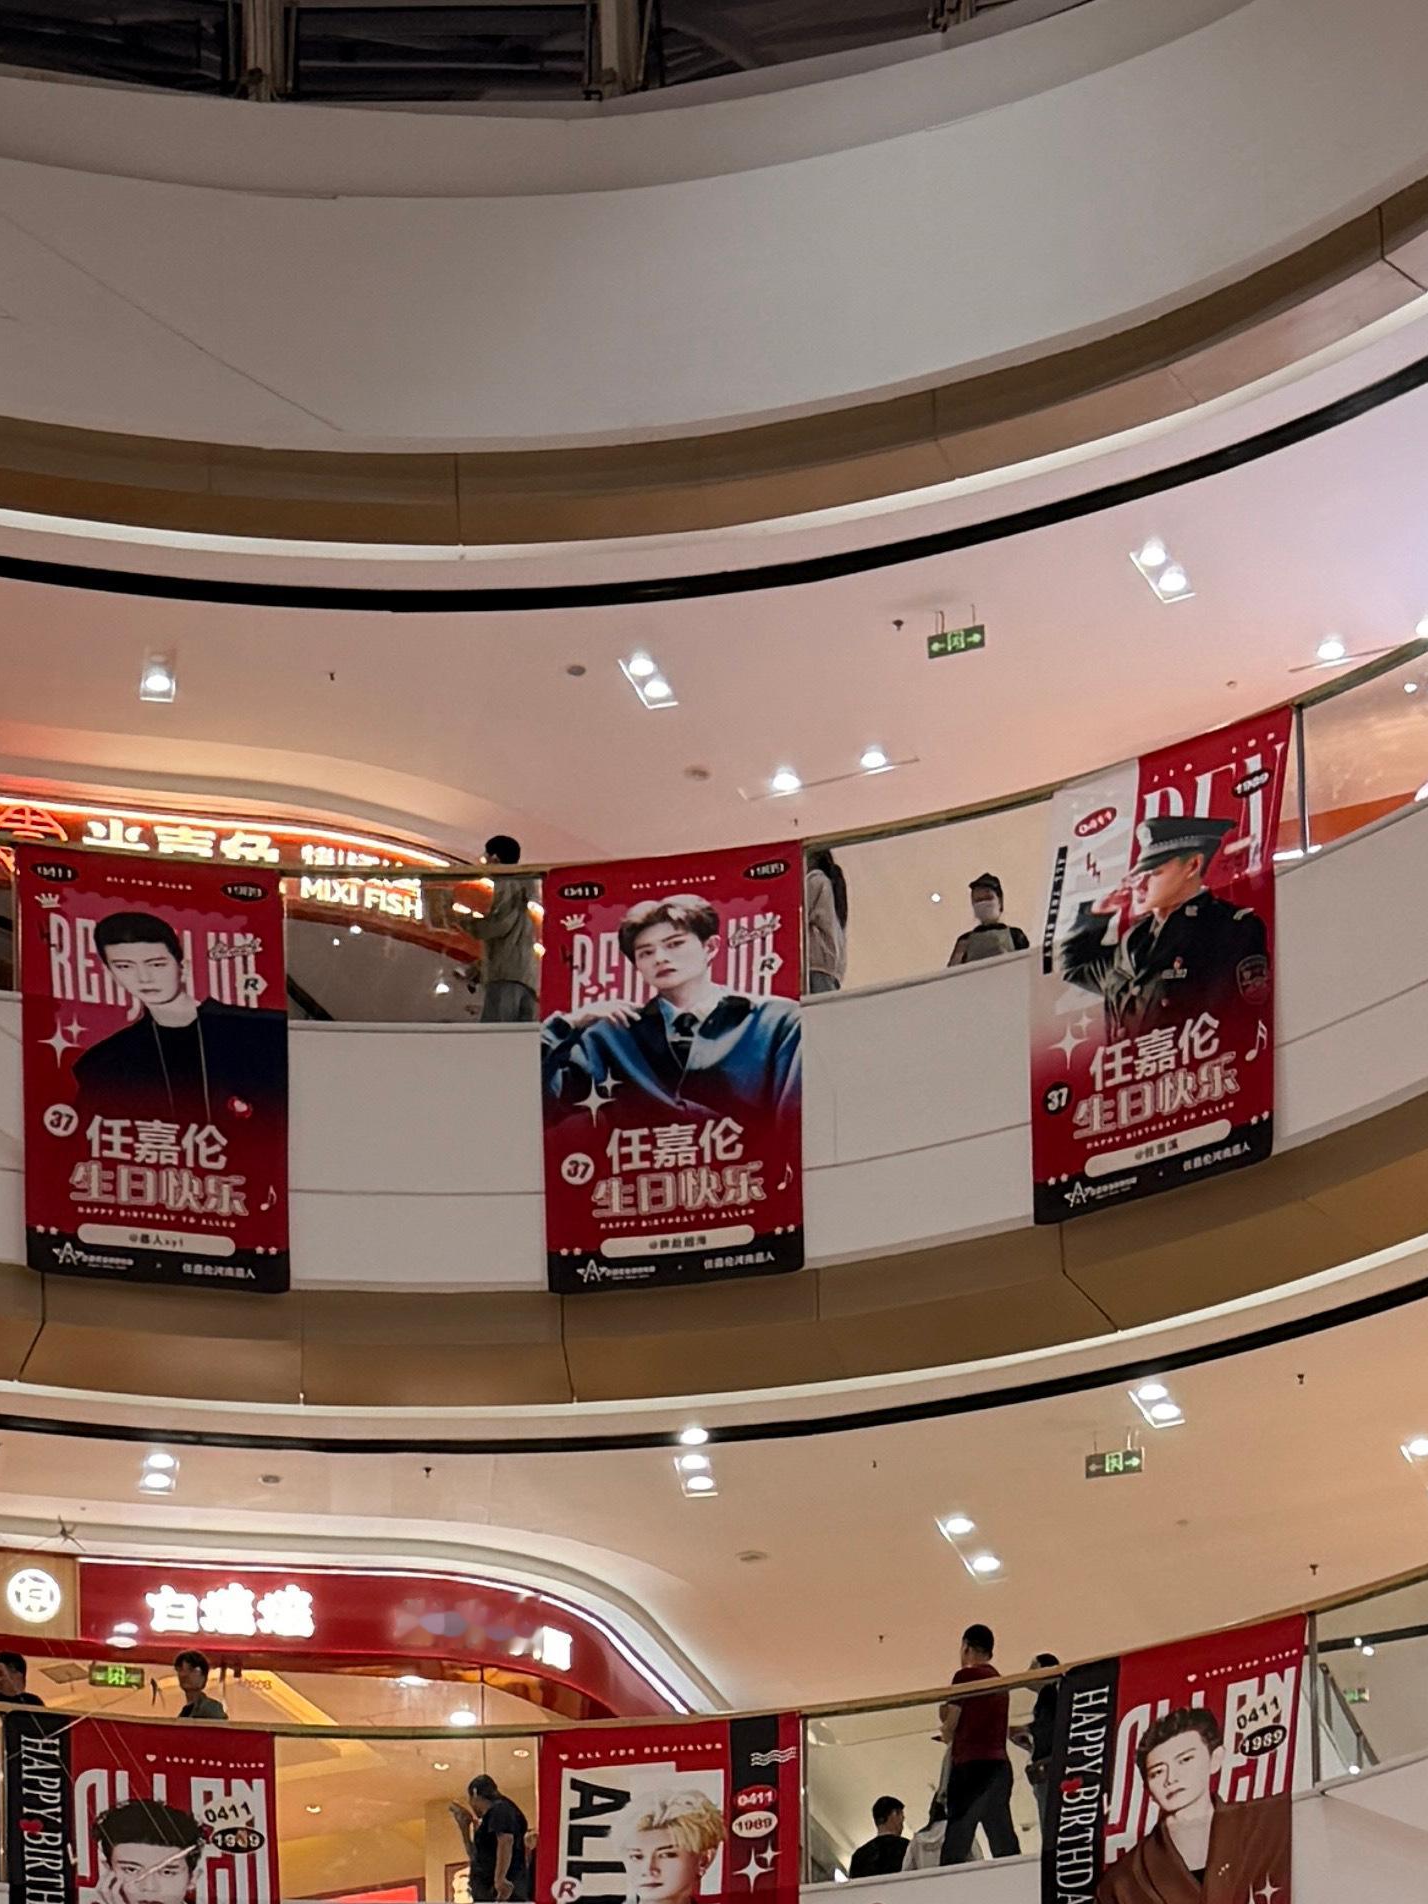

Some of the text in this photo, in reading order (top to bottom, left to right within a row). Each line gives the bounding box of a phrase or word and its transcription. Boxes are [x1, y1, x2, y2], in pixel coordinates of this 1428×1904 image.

[300, 875, 423, 920] MIXI FISH
[1089, 1012, 1220, 1093] 任嘉伦
[49, 1110, 73, 1131] 37
[1072, 1052, 1240, 1140] 生日快乐
[86, 1115, 228, 1170] 任嘉伦
[606, 1117, 744, 1170] 任嘉伦
[70, 1160, 249, 1216] 生日快乐
[592, 1161, 767, 1217] 生日快乐
[1070, 1685, 1108, 1774] HAPPY
[1235, 1696, 1279, 1730] 0411
[1241, 1729, 1284, 1752] 1989
[205, 1803, 251, 1823] 0411
